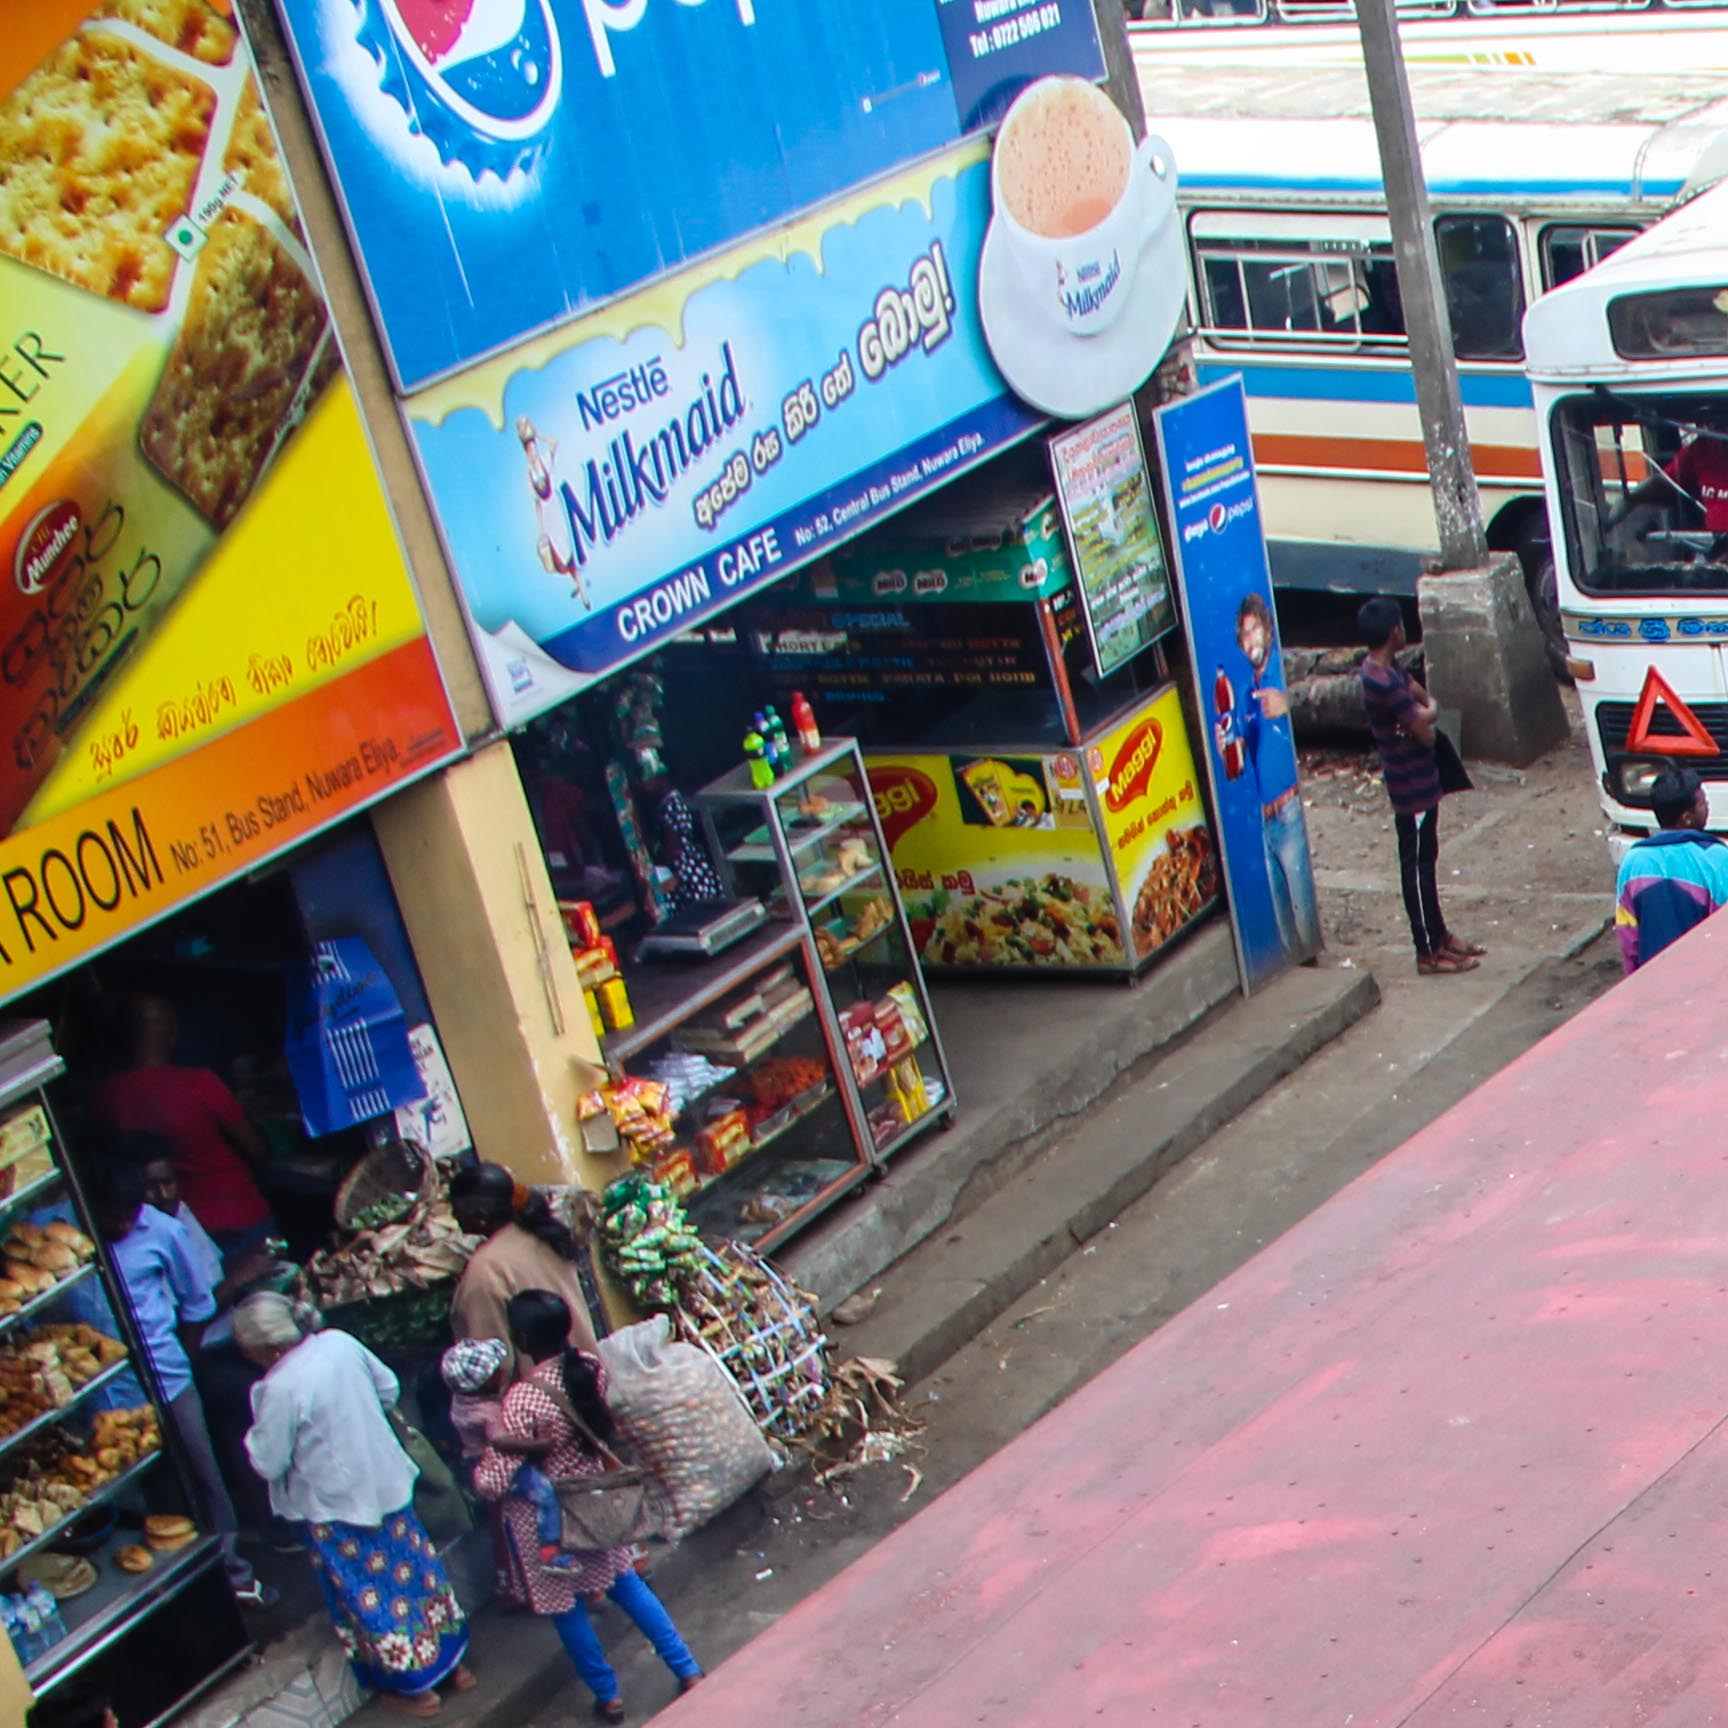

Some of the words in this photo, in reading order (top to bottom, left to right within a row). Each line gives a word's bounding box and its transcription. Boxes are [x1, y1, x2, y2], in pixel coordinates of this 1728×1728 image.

[1066, 247, 1121, 321] Milkmaid
[576, 354, 671, 432] Nestlé
[2, 425, 41, 468] Vitamins
[560, 339, 746, 568] Milkmaid
[26, 513, 79, 582] Munchee
[616, 564, 713, 643] CROWN
[717, 526, 783, 587] CAFE
[832, 494, 869, 524] Central
[870, 483, 892, 508] Bus
[889, 464, 922, 498] Stand,
[921, 444, 960, 475] Nuwara
[1638, 616, 1671, 643] ශ්‍රී
[1111, 728, 1157, 803] Maggi
[2, 807, 165, 953] ROOM
[170, 843, 204, 876] No:
[226, 811, 262, 848] Bus
[257, 784, 312, 830] Stand,
[305, 757, 366, 802] Nuwara
